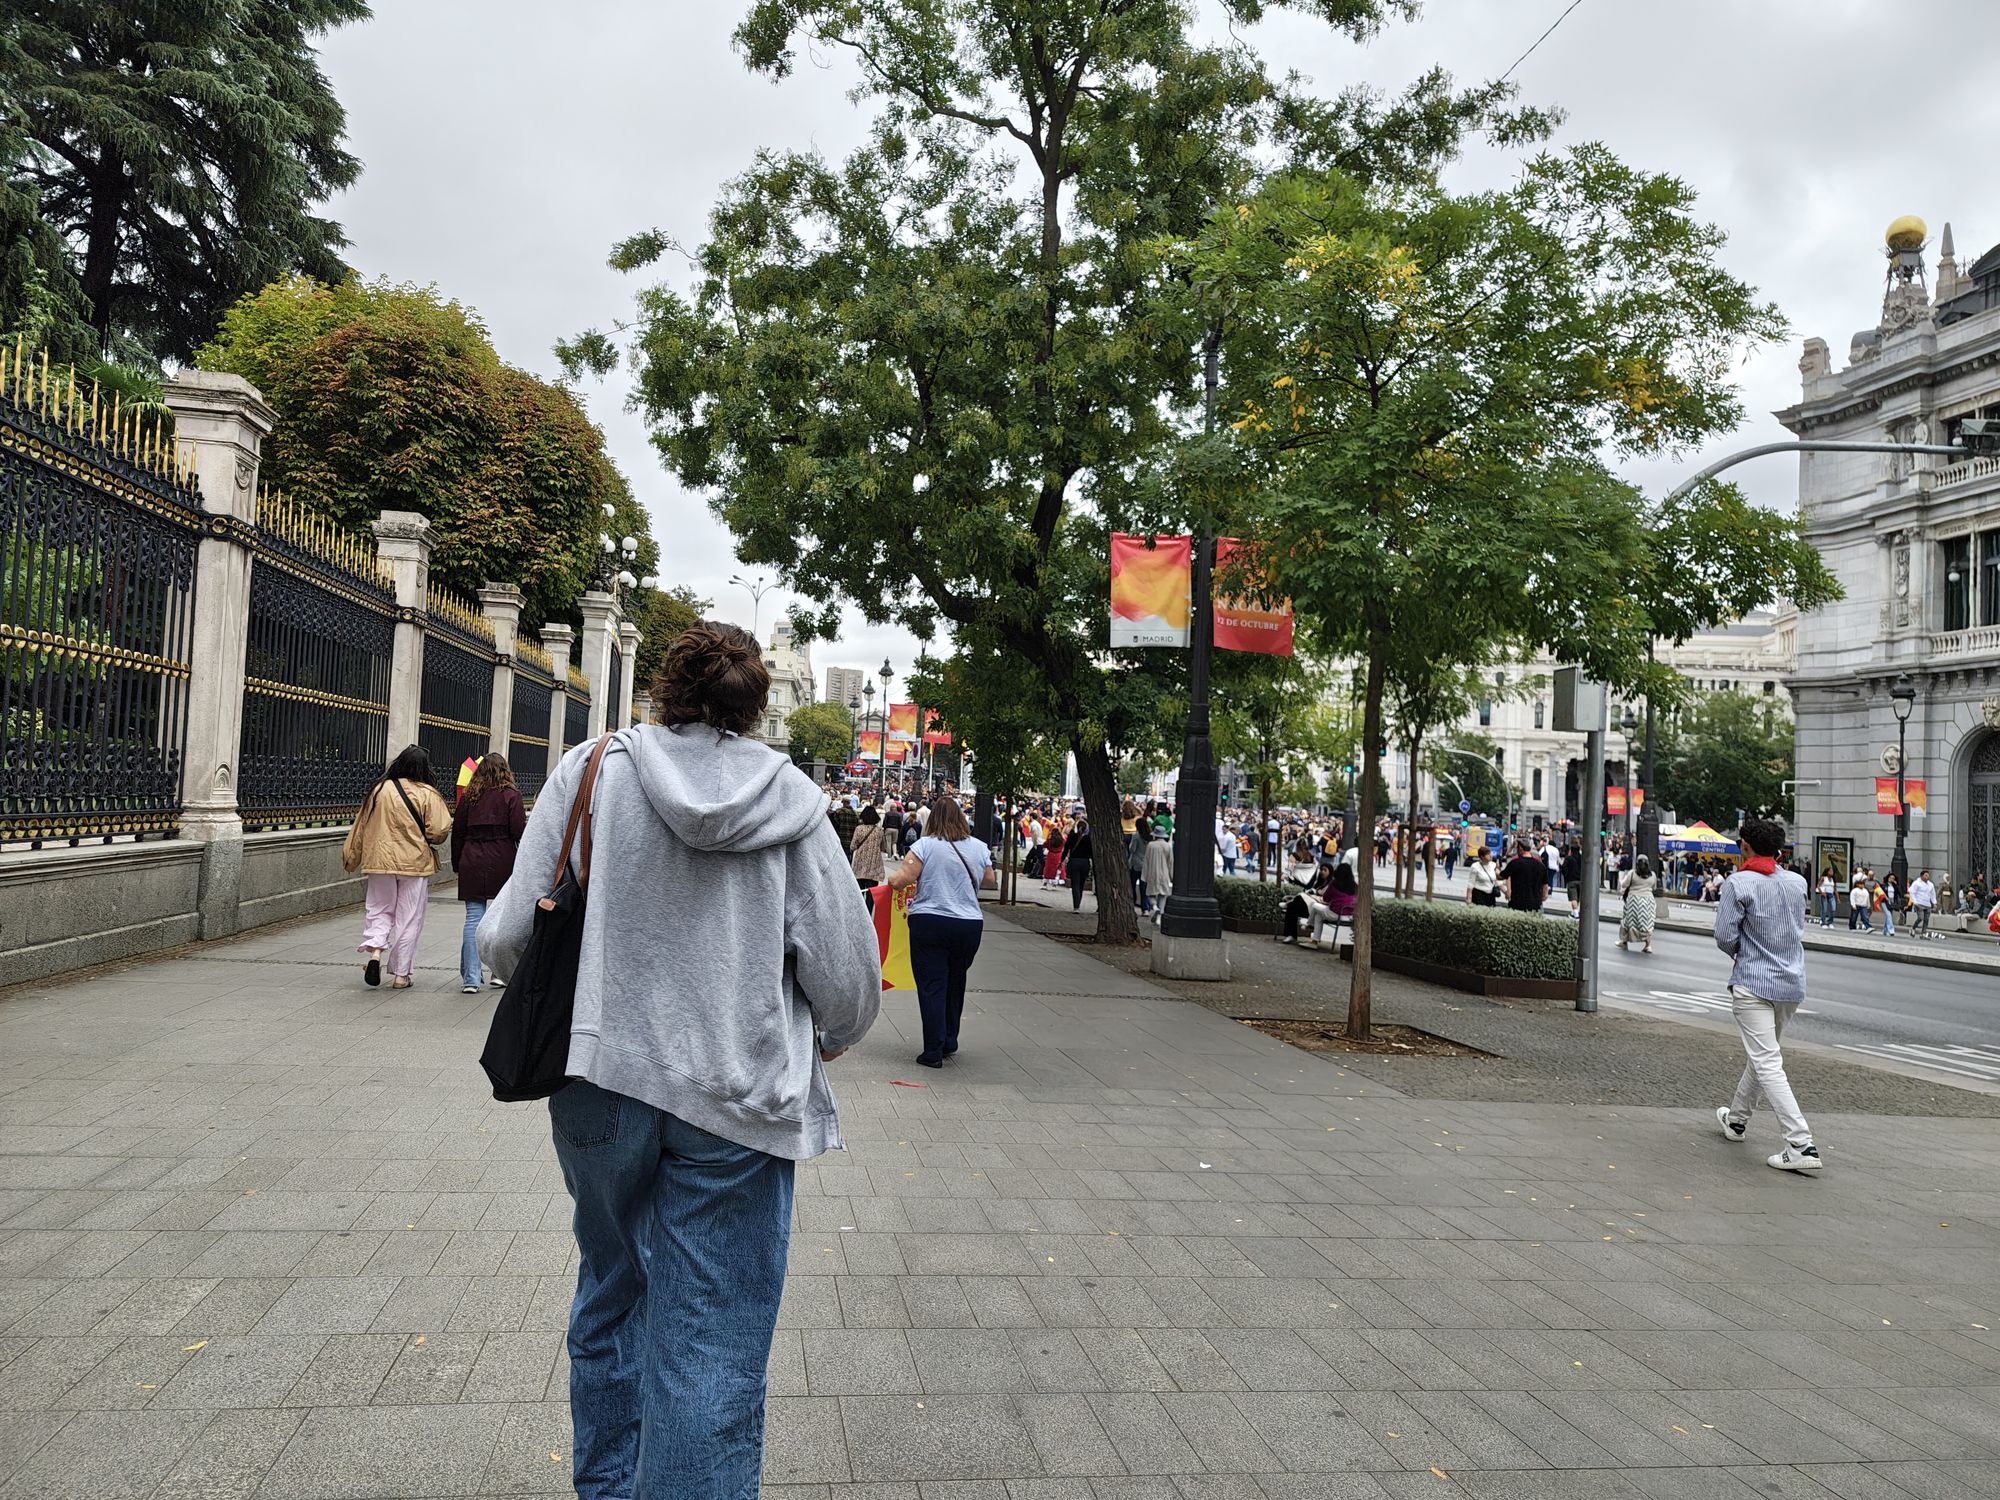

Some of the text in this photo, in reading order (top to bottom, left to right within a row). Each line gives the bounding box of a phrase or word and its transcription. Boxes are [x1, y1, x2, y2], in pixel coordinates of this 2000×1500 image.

[1217, 598, 1289, 616] NCIOAL
[1217, 616, 1280, 631] 12 DE OCTUBRE
[1142, 635, 1174, 643] MADRID
